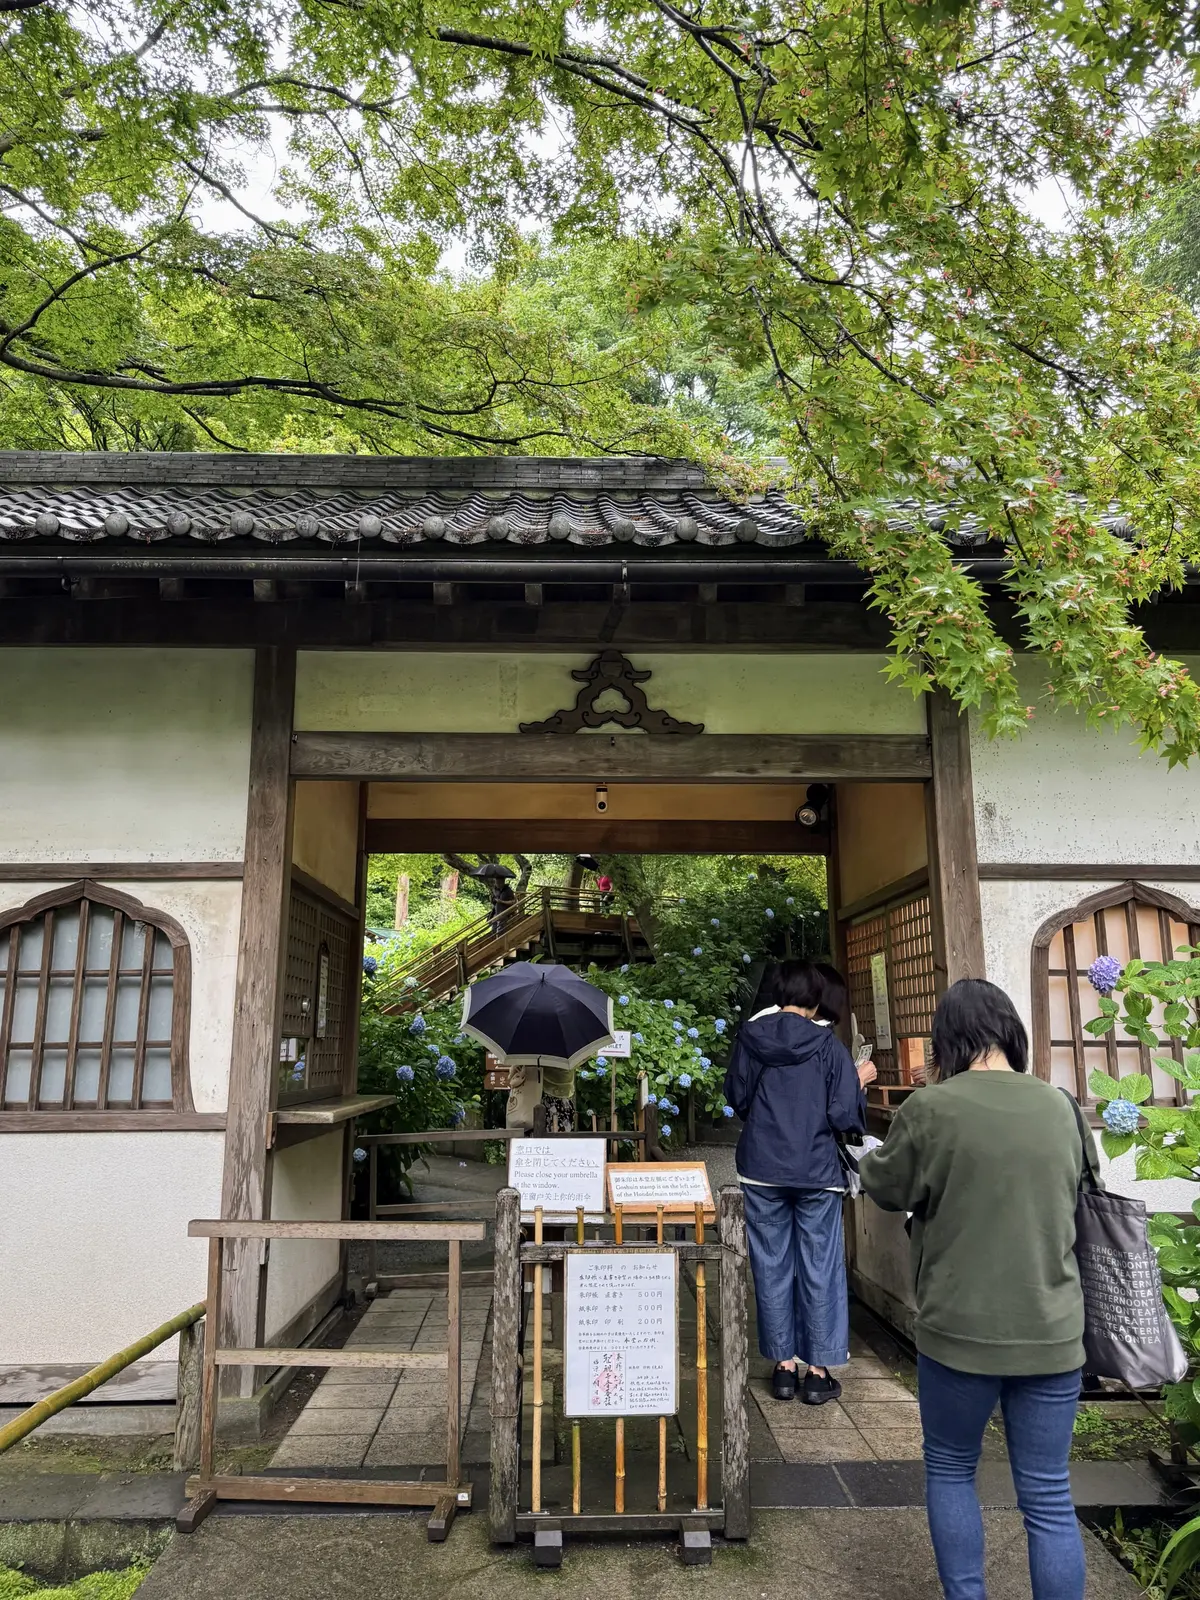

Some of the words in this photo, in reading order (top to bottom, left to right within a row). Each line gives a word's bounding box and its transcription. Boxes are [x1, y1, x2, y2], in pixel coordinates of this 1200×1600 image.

[516, 1145, 551, 1154] 窓口では
[515, 1157, 600, 1168] 傘を閉じてください。
[569, 1171, 598, 1179] umbrella
[521, 1181, 531, 1189] the
[532, 1181, 560, 1189] window.
[588, 1264, 613, 1272] ご朱印料
[579, 1291, 599, 1299] 朱印帳
[605, 1291, 623, 1299] 直書き
[605, 1305, 623, 1313] 手書き
